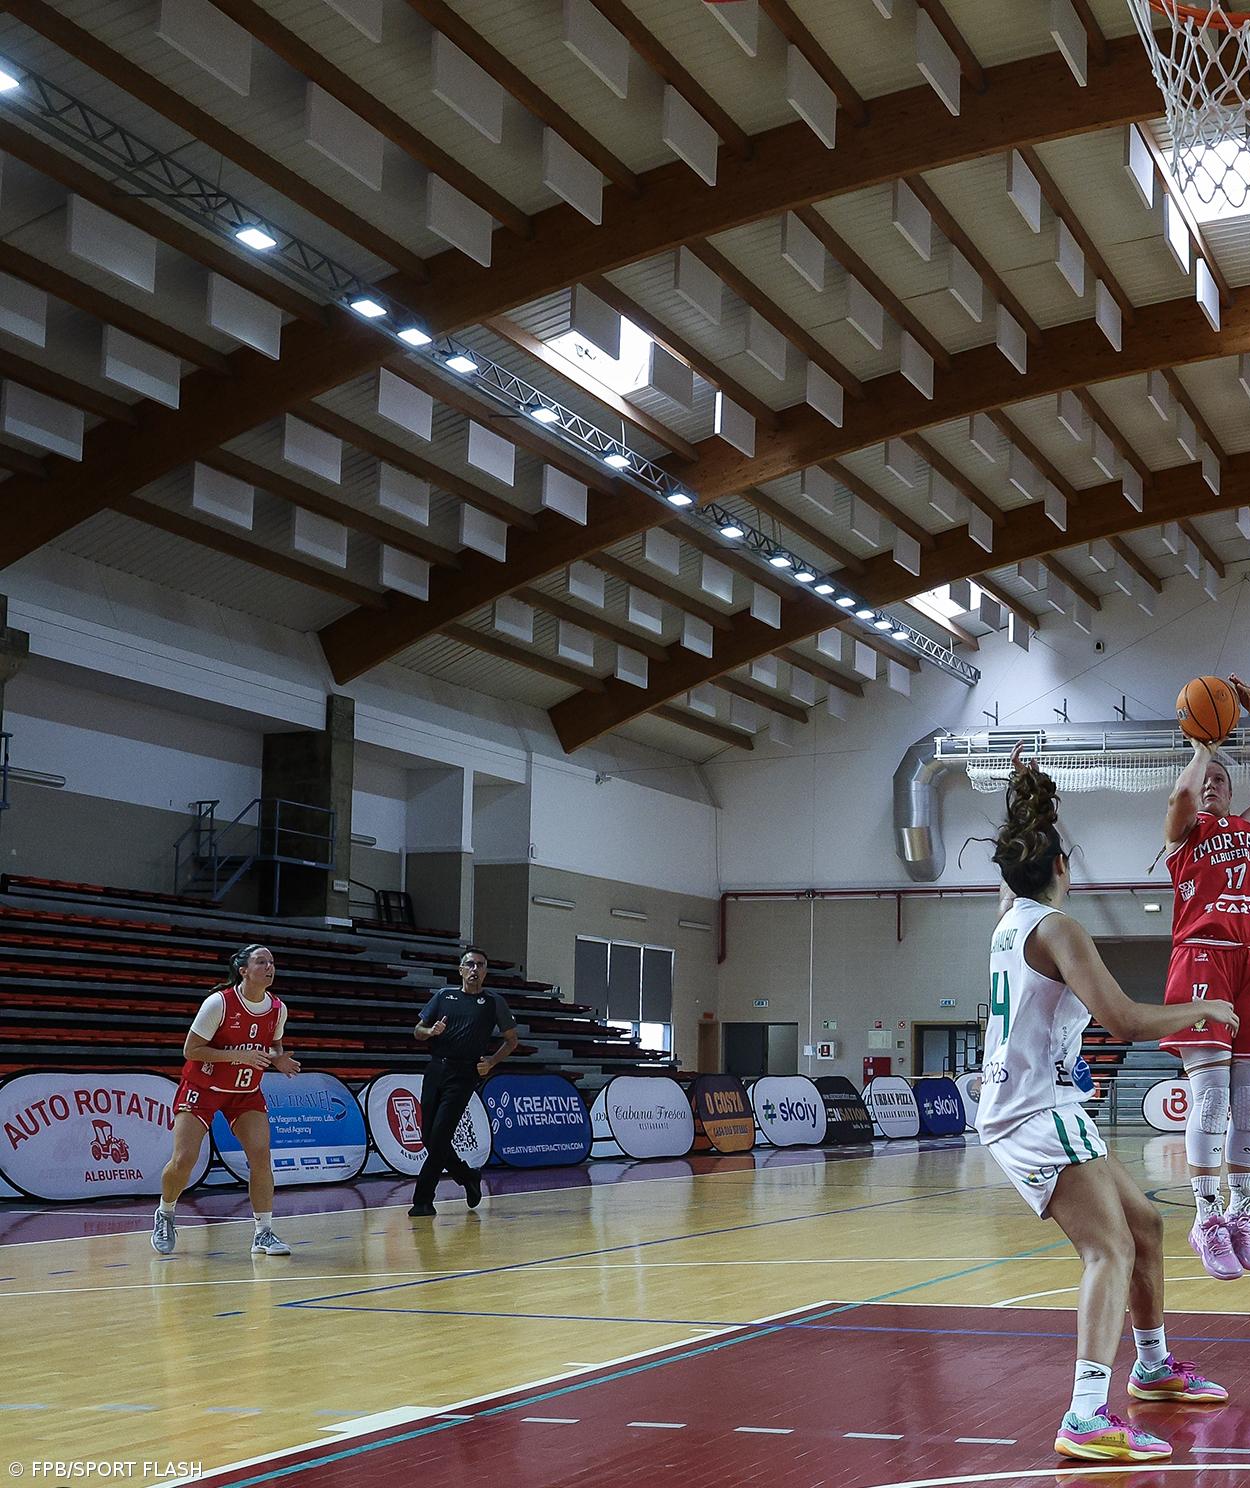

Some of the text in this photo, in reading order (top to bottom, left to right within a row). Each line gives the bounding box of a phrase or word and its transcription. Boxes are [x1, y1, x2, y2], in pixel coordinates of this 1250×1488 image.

[1210, 848, 1250, 865] ALBUFEIR
[1225, 863, 1247, 889] 17
[1192, 983, 1209, 1000] 17
[991, 970, 1010, 1046] 4
[234, 1068, 254, 1088] 13
[186, 1089, 199, 1104] 13
[287, 1090, 334, 1113] TRAVEL
[513, 1096, 581, 1113] KREATIVE
[704, 1091, 744, 1115] O COSTA
[873, 1093, 913, 1106] URBAN PIZZA
[612, 1104, 652, 1121] Cabana
[656, 1105, 687, 1120] Fresca
[779, 1097, 817, 1128] skoiy
[933, 1094, 959, 1120] skoiy
[3, 1088, 176, 1150] AUTO ROTATIV
[276, 1116, 298, 1124] Viagens
[517, 1112, 584, 1126] INTERACTION
[291, 1127, 312, 1135] Agency
[400, 1149, 428, 1161] ALBUFEIR
[502, 1142, 584, 1154] KREATIVEINTERACTION.COM
[85, 1169, 144, 1182] ALBUFEIRA
